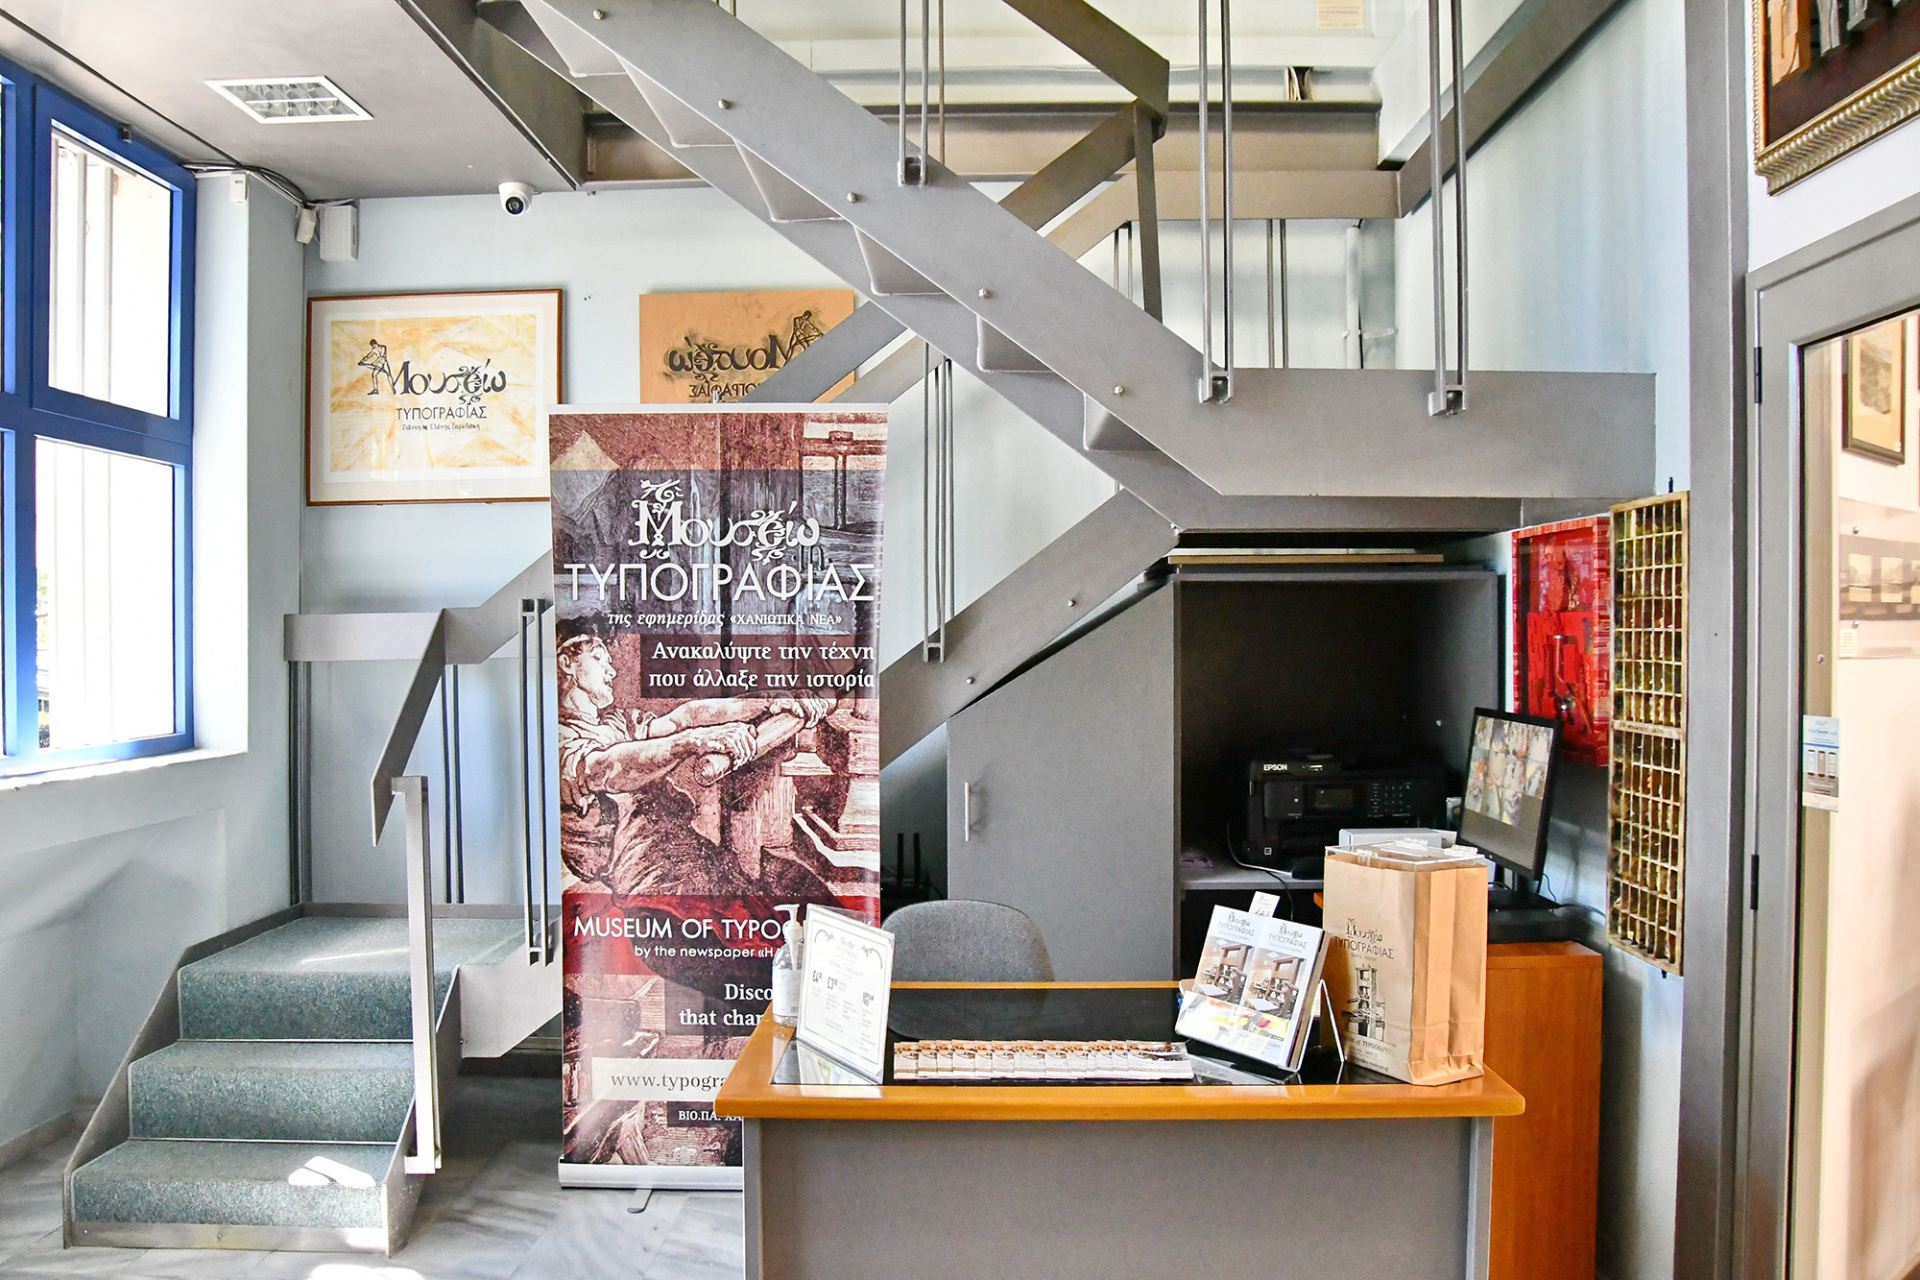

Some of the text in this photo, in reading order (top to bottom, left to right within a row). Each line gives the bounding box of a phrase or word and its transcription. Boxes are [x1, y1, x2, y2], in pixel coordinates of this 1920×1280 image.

[396, 405, 487, 420] ΤΥΠΟΓΡΑΦΙΑΣ
[563, 562, 876, 601] ΤΥΠΟΓΡΑΦΙΑΣ
[608, 612, 631, 626] της
[637, 611, 725, 628] εφημερίδας
[651, 641, 875, 664] Ανακαλύψτε την τέχνη
[649, 669, 875, 690] που άλλαξε την ιστορία
[1263, 763, 1288, 772] EPSON
[573, 916, 782, 940] MUSEUM OF TYPO
[634, 945, 650, 959] by
[655, 945, 677, 957] the
[680, 947, 754, 960] newspaper
[1334, 936, 1394, 960] ΤΥΠΟΓΡΑΦΙΑΣ
[724, 983, 773, 1001] Disco
[679, 1008, 717, 1026] that
